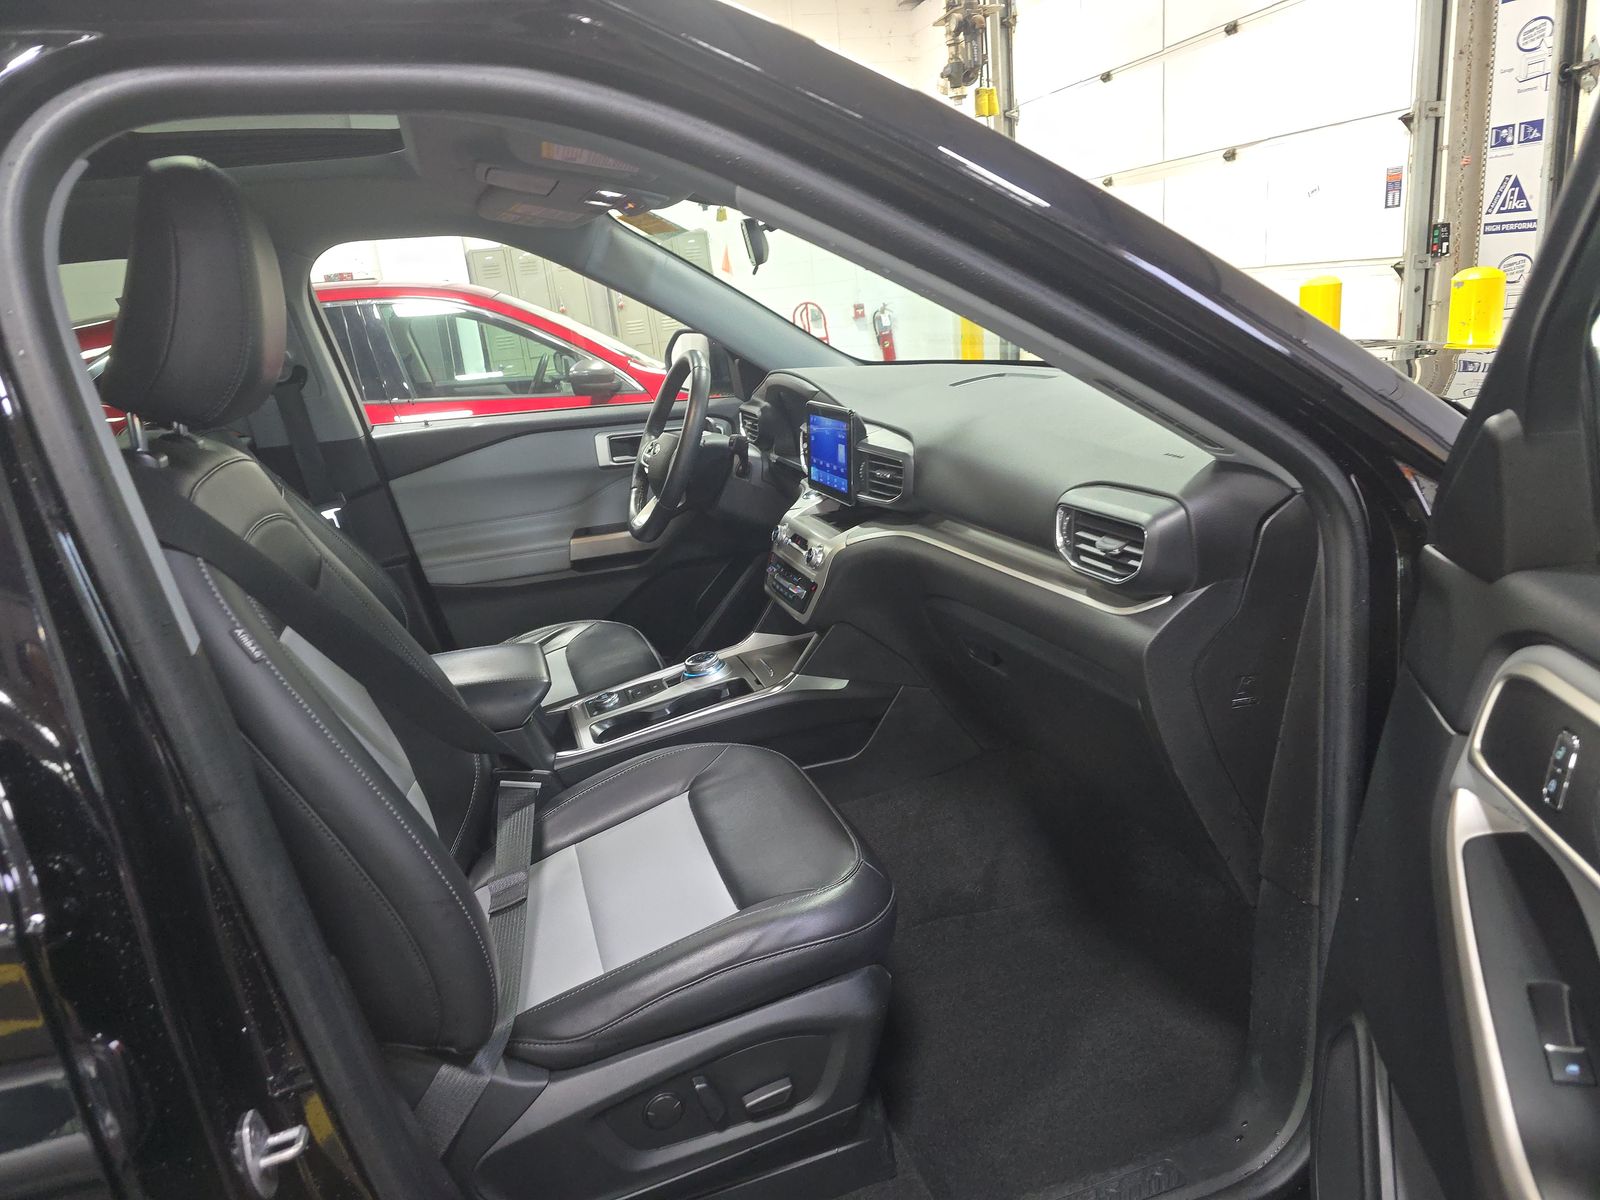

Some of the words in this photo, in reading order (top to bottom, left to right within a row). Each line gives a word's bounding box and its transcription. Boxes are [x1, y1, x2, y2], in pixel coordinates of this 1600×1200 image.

[1500, 187, 1527, 211] Sika
[1485, 224, 1500, 233] HIGH
[1503, 259, 1526, 269] COMPLETE
